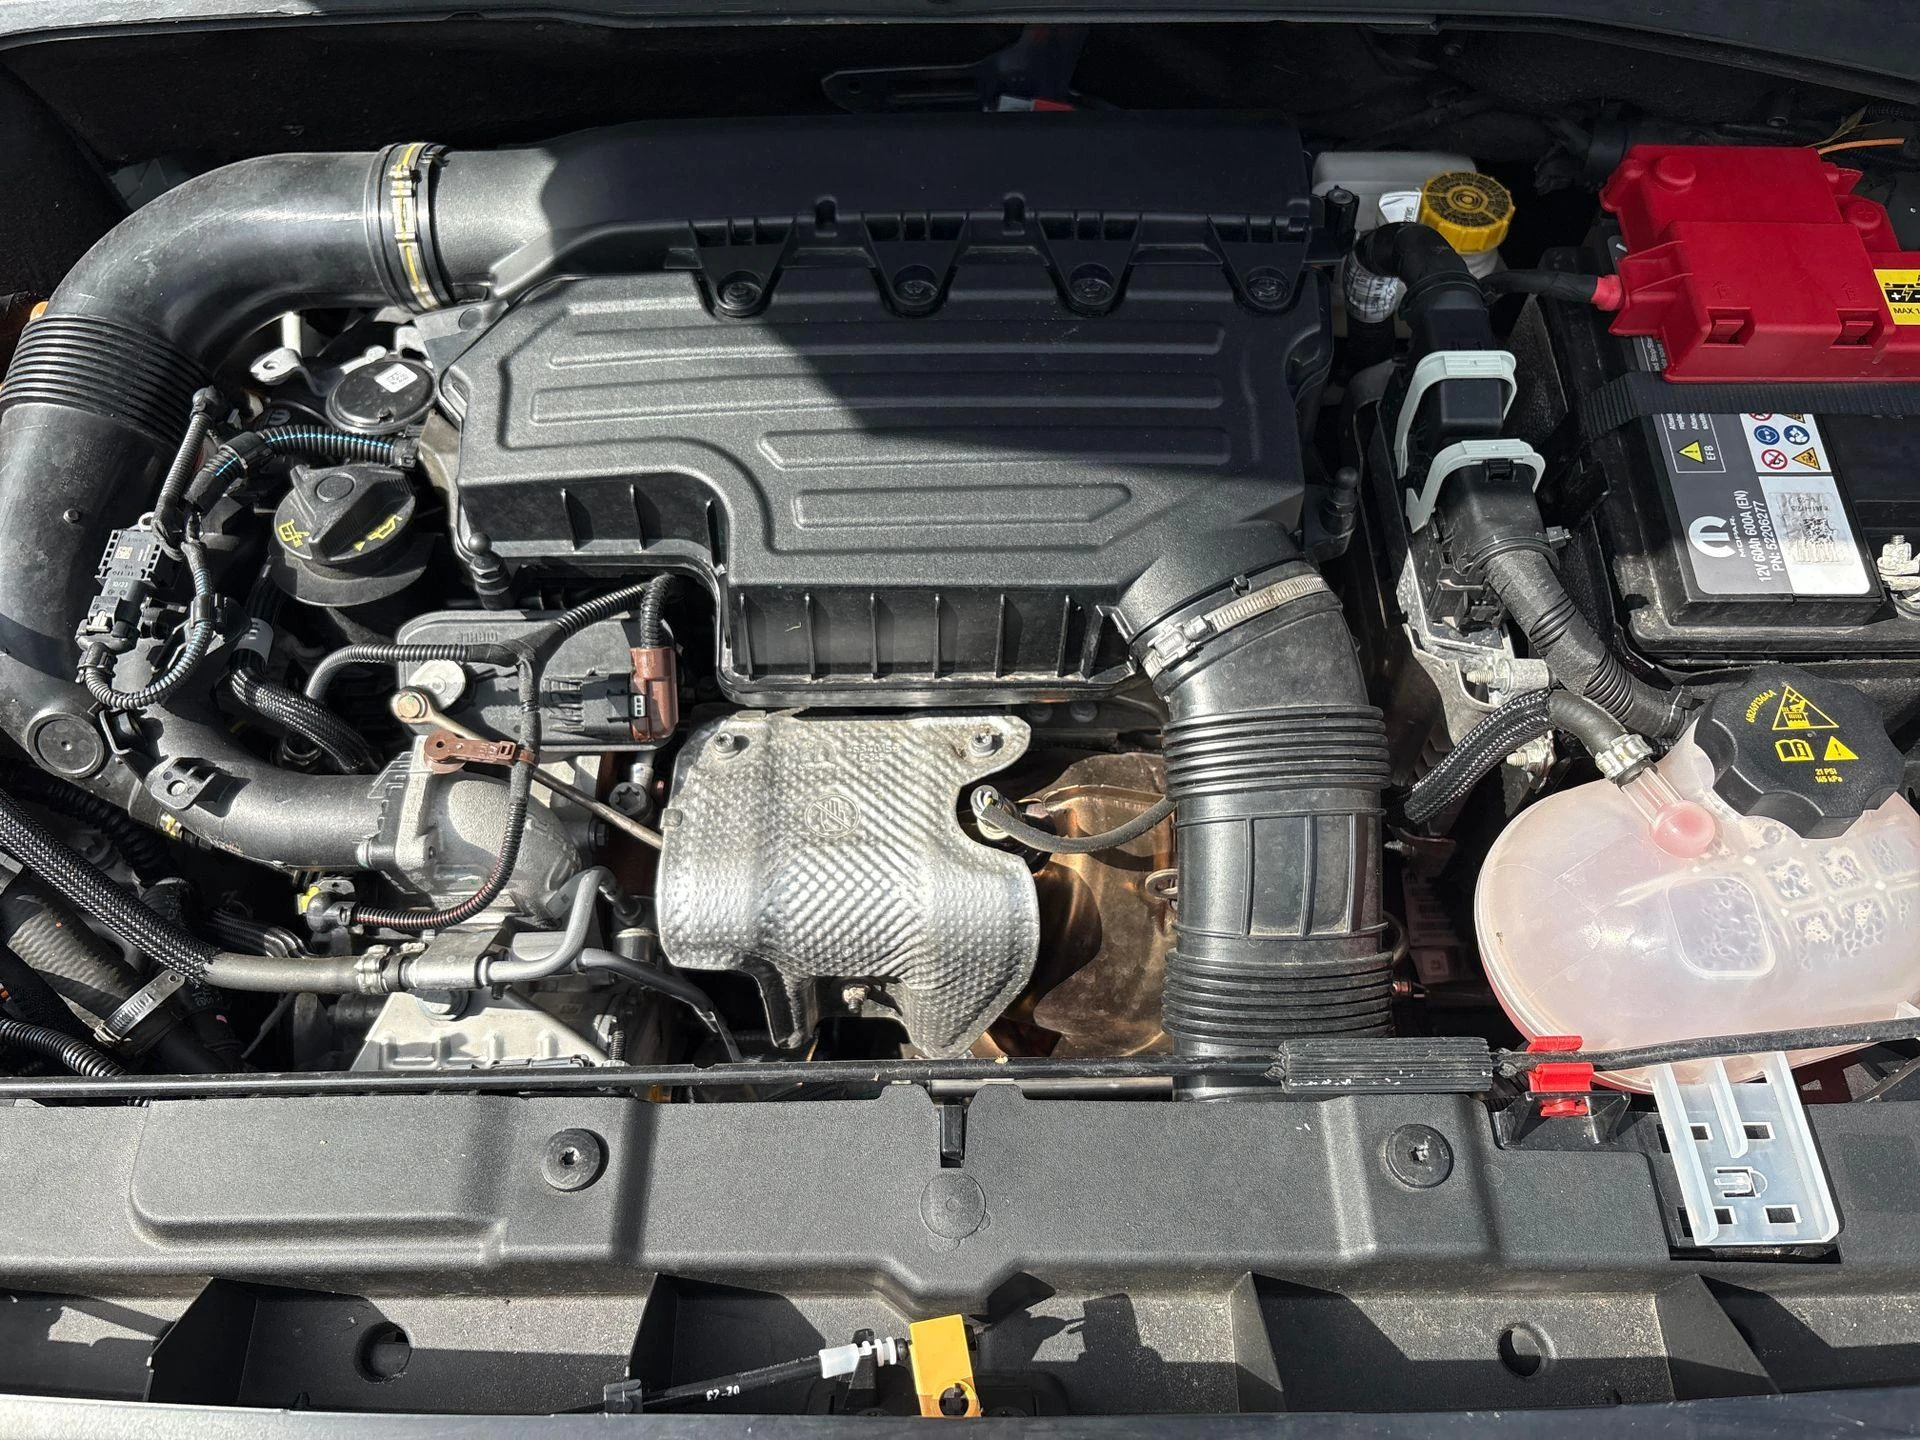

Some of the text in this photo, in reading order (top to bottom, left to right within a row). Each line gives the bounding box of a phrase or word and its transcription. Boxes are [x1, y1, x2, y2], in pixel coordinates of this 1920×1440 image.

[1893, 307, 1914, 315] MAX
[1705, 445, 1716, 461] EFB
[1734, 490, 1771, 582] 12V 60Ah 600A (EN)
[1753, 500, 1784, 572] PN: 52206277
[1824, 767, 1837, 775] PSI
[1814, 775, 1843, 783] 145 kPa
